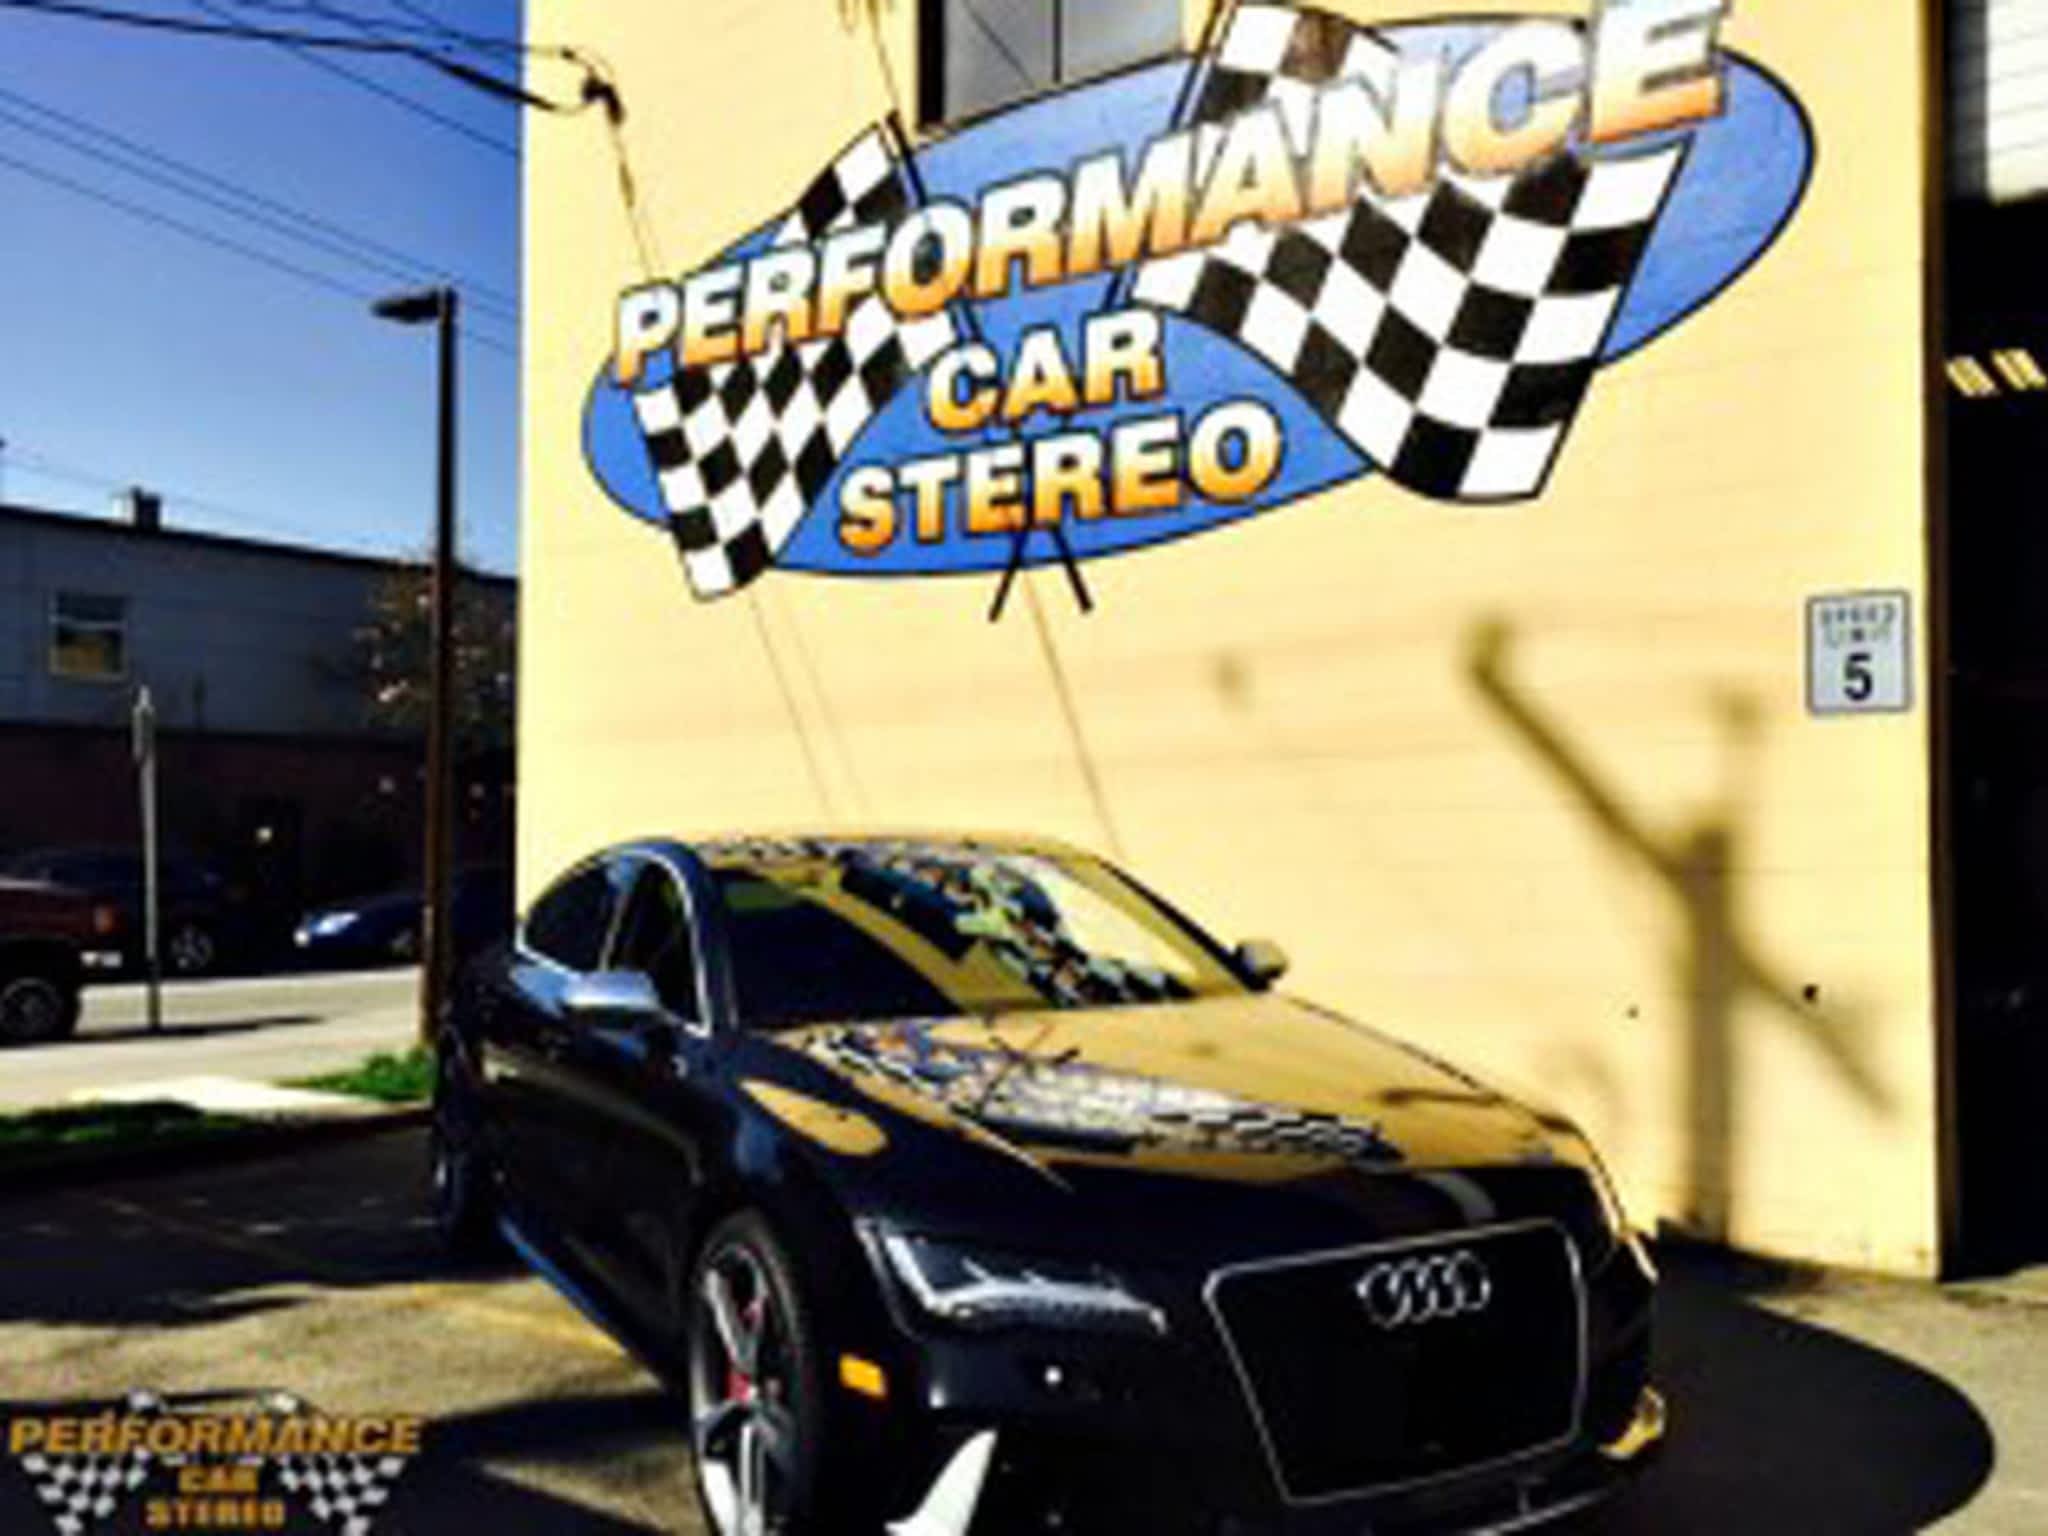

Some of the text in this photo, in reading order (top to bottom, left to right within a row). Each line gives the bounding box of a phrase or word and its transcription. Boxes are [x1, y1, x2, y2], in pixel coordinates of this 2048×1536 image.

[611, 0, 1732, 387] PERFORMANCE
[924, 310, 1165, 432] CAR
[837, 402, 1284, 555] STEREO
[1843, 652, 1873, 702] 5
